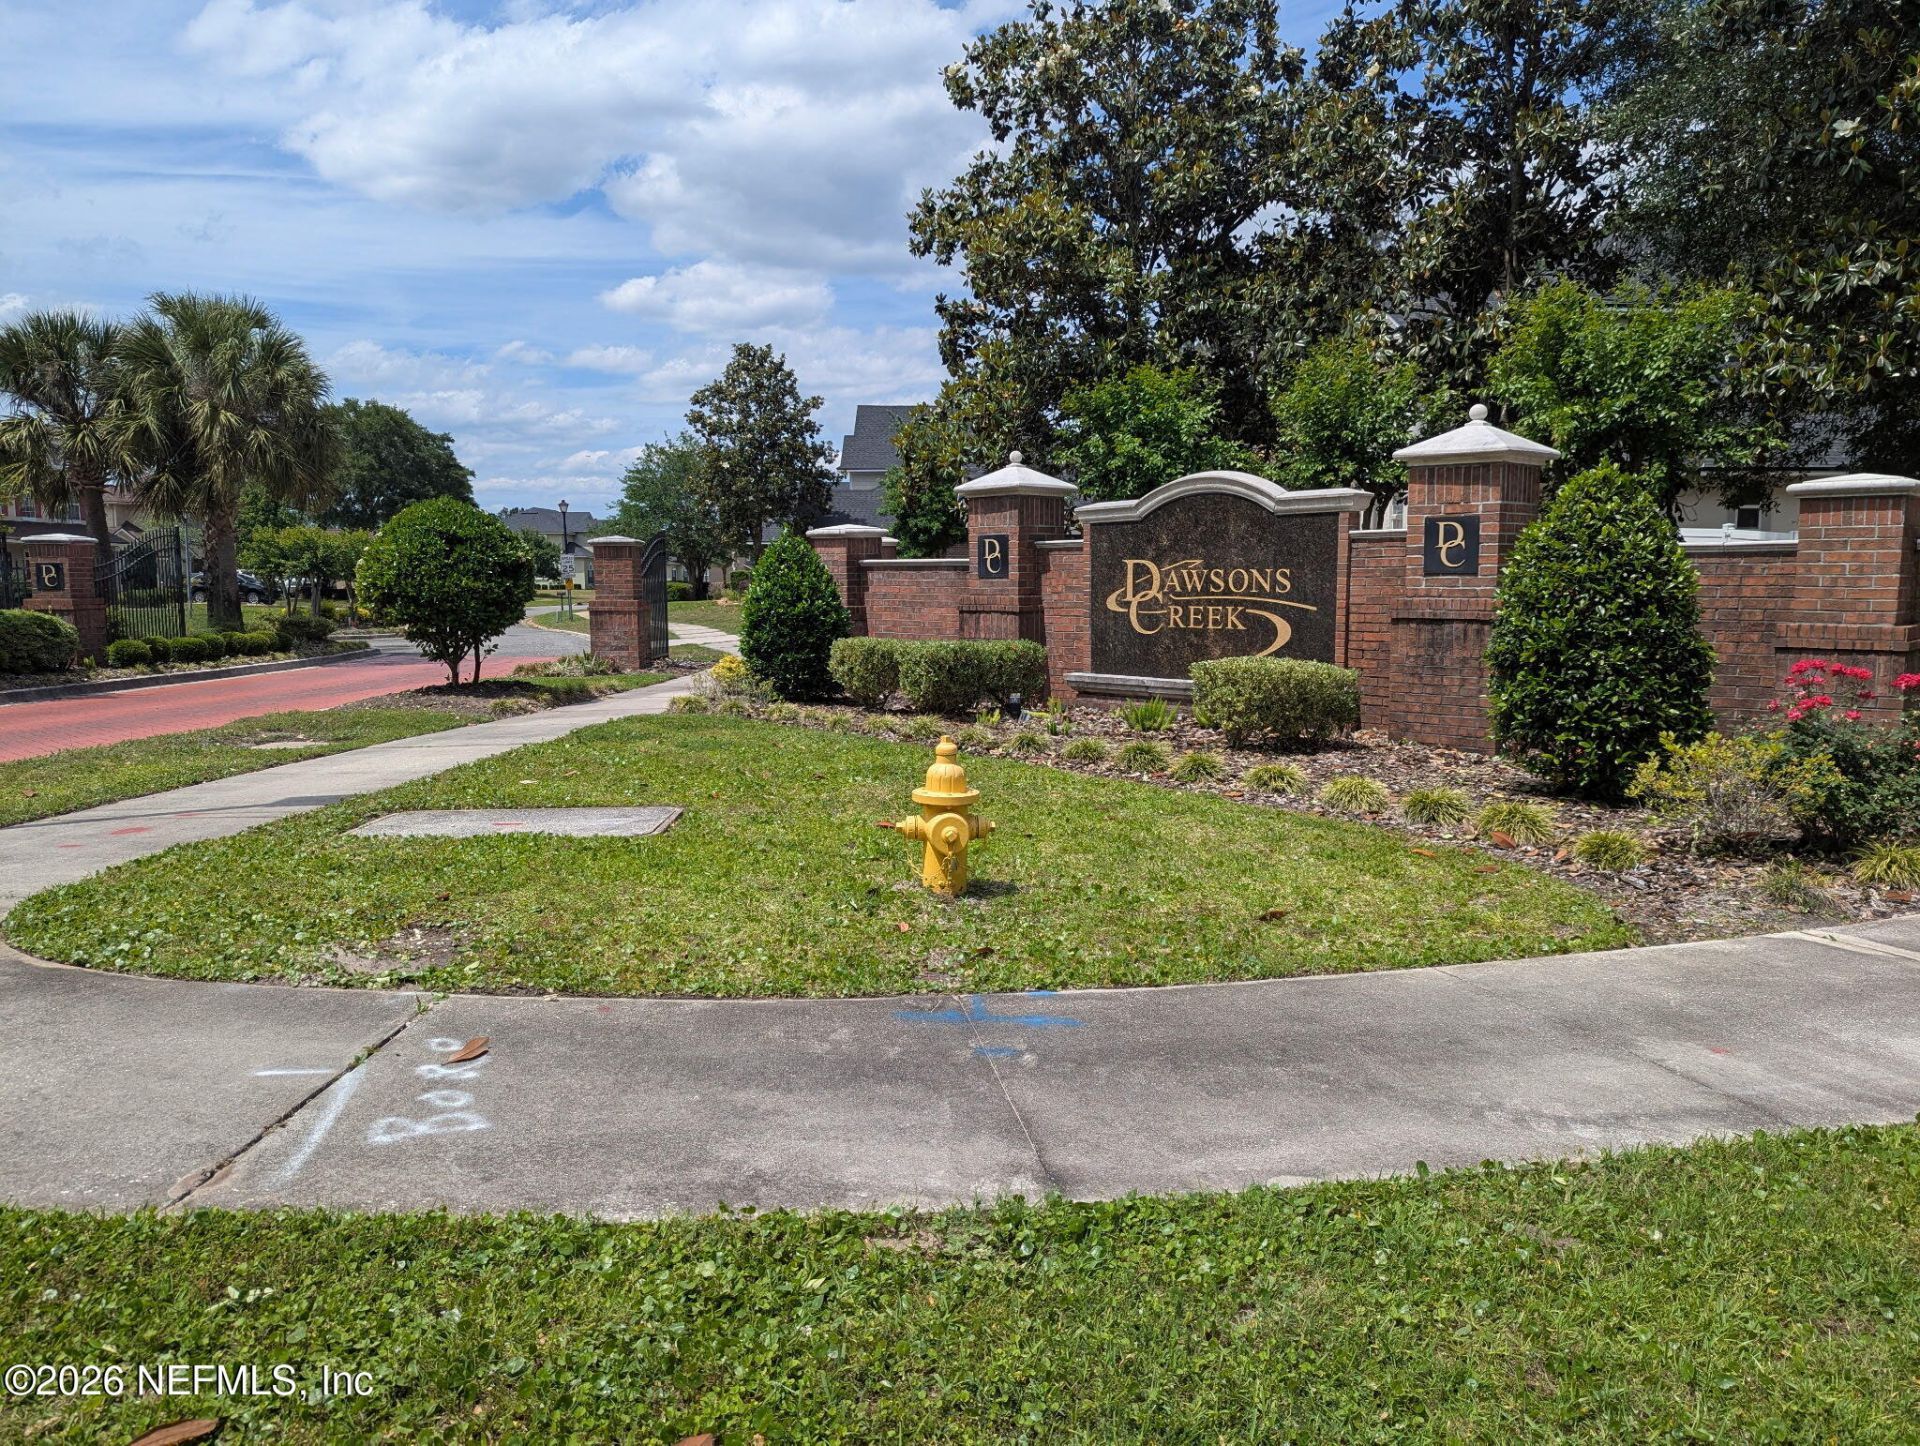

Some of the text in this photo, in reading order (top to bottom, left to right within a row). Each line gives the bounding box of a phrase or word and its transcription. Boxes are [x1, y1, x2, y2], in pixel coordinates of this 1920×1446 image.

[562, 564, 575, 573] 25
[1122, 559, 1291, 601] DAWSONS
[1129, 590, 1247, 635] CREEK
